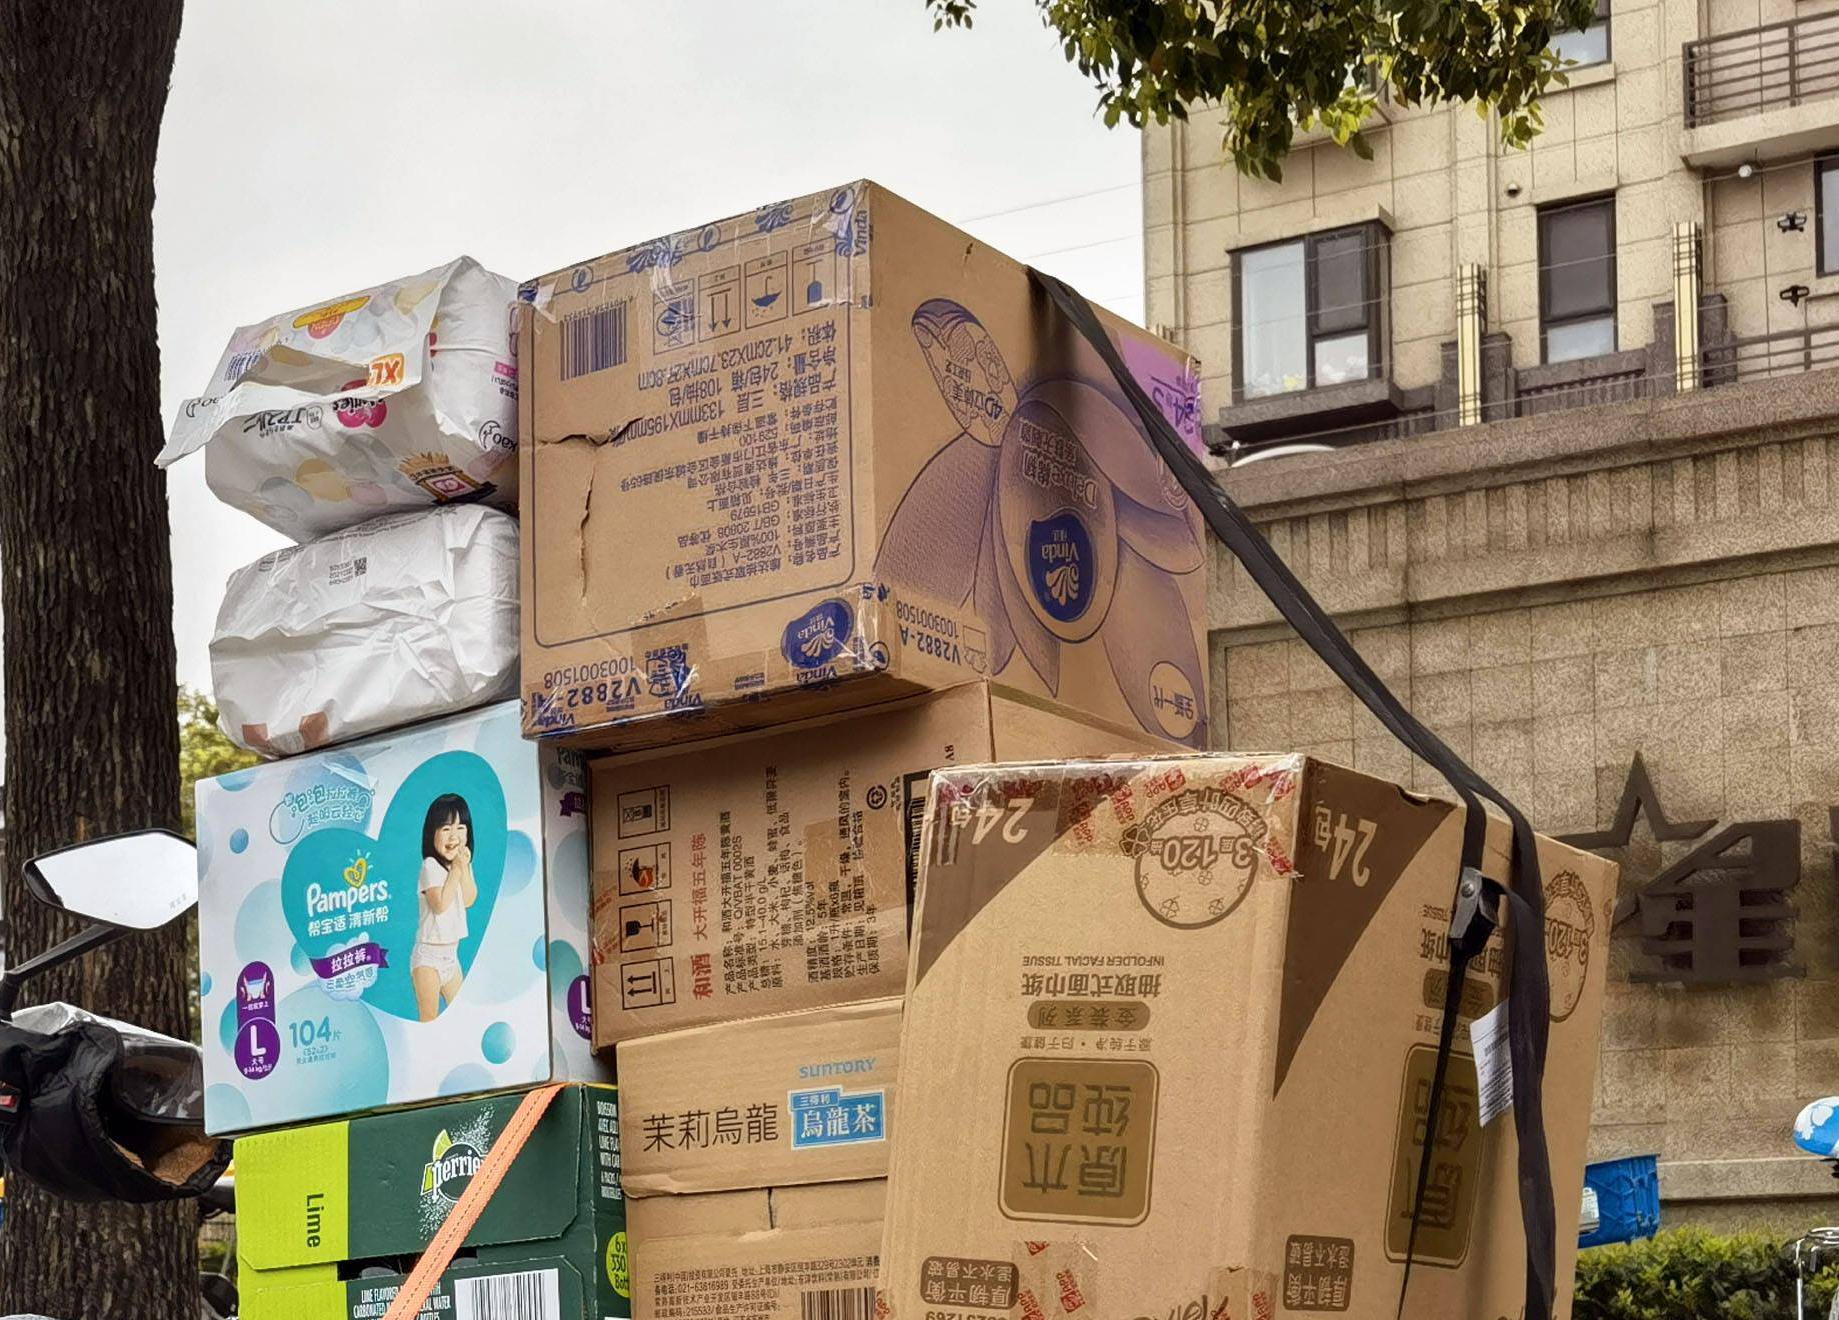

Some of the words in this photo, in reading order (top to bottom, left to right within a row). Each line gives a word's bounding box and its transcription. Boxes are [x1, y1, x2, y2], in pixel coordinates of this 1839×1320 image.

[372, 361, 400, 385] XL
[1042, 542, 1078, 561] Vinda
[797, 616, 836, 640] Vinda
[896, 601, 960, 639] 1003001508
[899, 625, 962, 666] V2882-A
[544, 656, 636, 689] 1003001508
[306, 878, 389, 917] Pampers
[692, 833, 709, 941] 大开福五年陈
[308, 915, 347, 937] 帮宝适
[348, 907, 389, 930] 清新帮
[331, 948, 367, 973] 拉拉裤
[691, 953, 713, 1000] 和酒
[1023, 956, 1062, 967] TISSUE
[1064, 956, 1104, 967] FACIAL
[1107, 956, 1164, 967] INFOLDER
[1021, 972, 1162, 997] 抽取式面巾纸
[1037, 1006, 1138, 1027] 金装系列
[250, 1025, 266, 1056] L
[801, 1104, 876, 1139] 烏龍茶
[1028, 1082, 1132, 1137] 纯品
[643, 1103, 778, 1153] 茉莉烏龍
[432, 1150, 484, 1203] perrie
[1022, 1143, 1127, 1197] 原木
[306, 1193, 325, 1248] Lime
[925, 1280, 1011, 1304] 厚韧平衡
